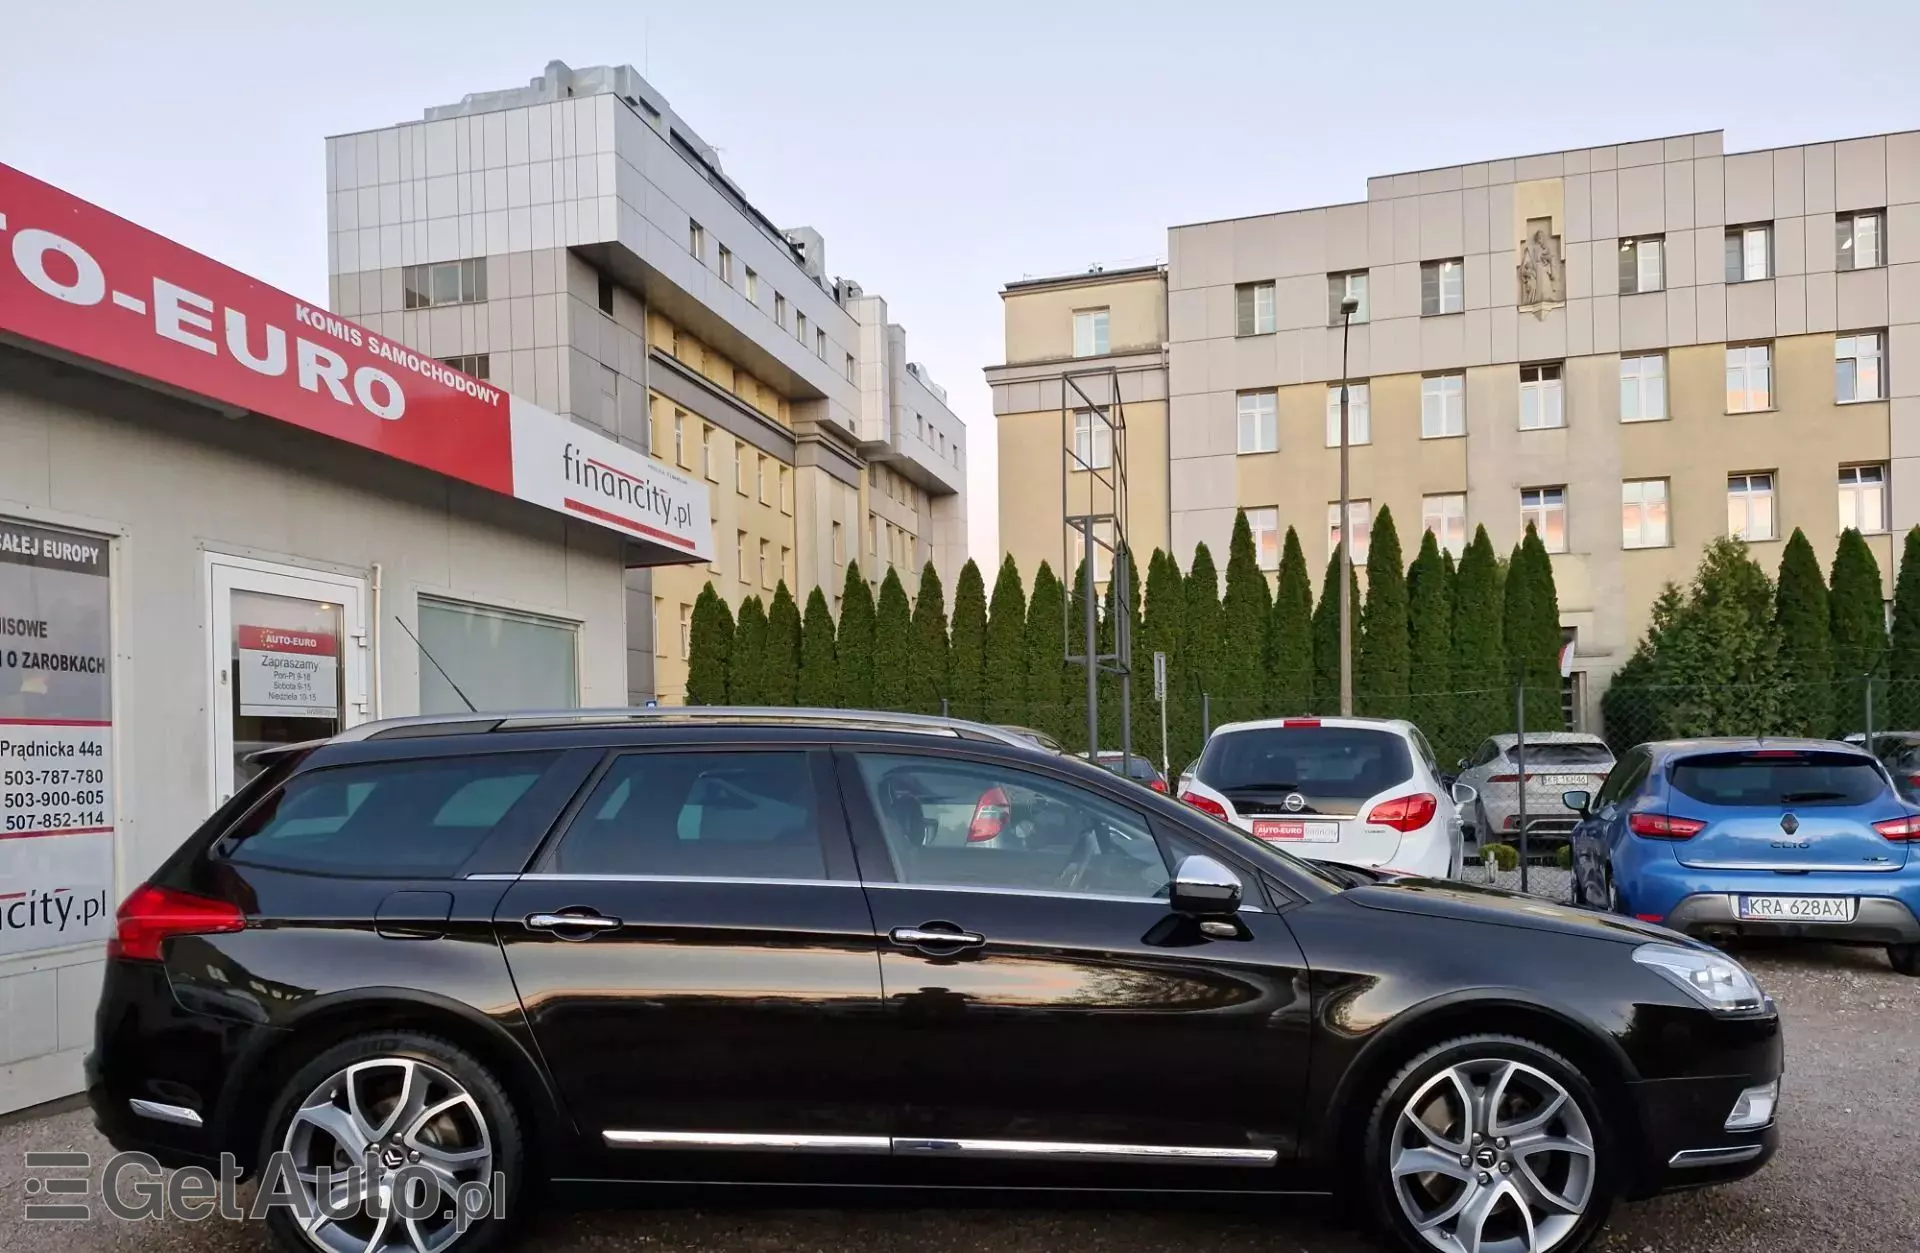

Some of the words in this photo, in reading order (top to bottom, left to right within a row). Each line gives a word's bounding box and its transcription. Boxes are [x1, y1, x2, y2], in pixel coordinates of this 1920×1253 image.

[0, 213, 406, 421] O-EURO
[295, 302, 364, 348] KOMIS
[368, 336, 500, 407] SAMOCHODOWY
[563, 443, 692, 529] financity.pl
[43, 539, 99, 565] EUROPY
[0, 616, 48, 639] ISOWE
[265, 635, 317, 648] AUTO-EURO
[7, 651, 18, 668] O
[22, 651, 106, 674] ZAROBKACH
[0, 740, 75, 762] Prądnicka
[78, 741, 103, 757] 44a
[4, 769, 104, 786] 503-787-780
[4, 790, 104, 808] 503-900-605
[6, 811, 105, 831] 507-852-114
[1257, 826, 1303, 835] AUTO-EURO
[1770, 841, 1810, 849] CLIO
[0, 889, 107, 932] city.pl
[1749, 898, 1784, 915] KRA
[1789, 899, 1845, 916] 628AX
